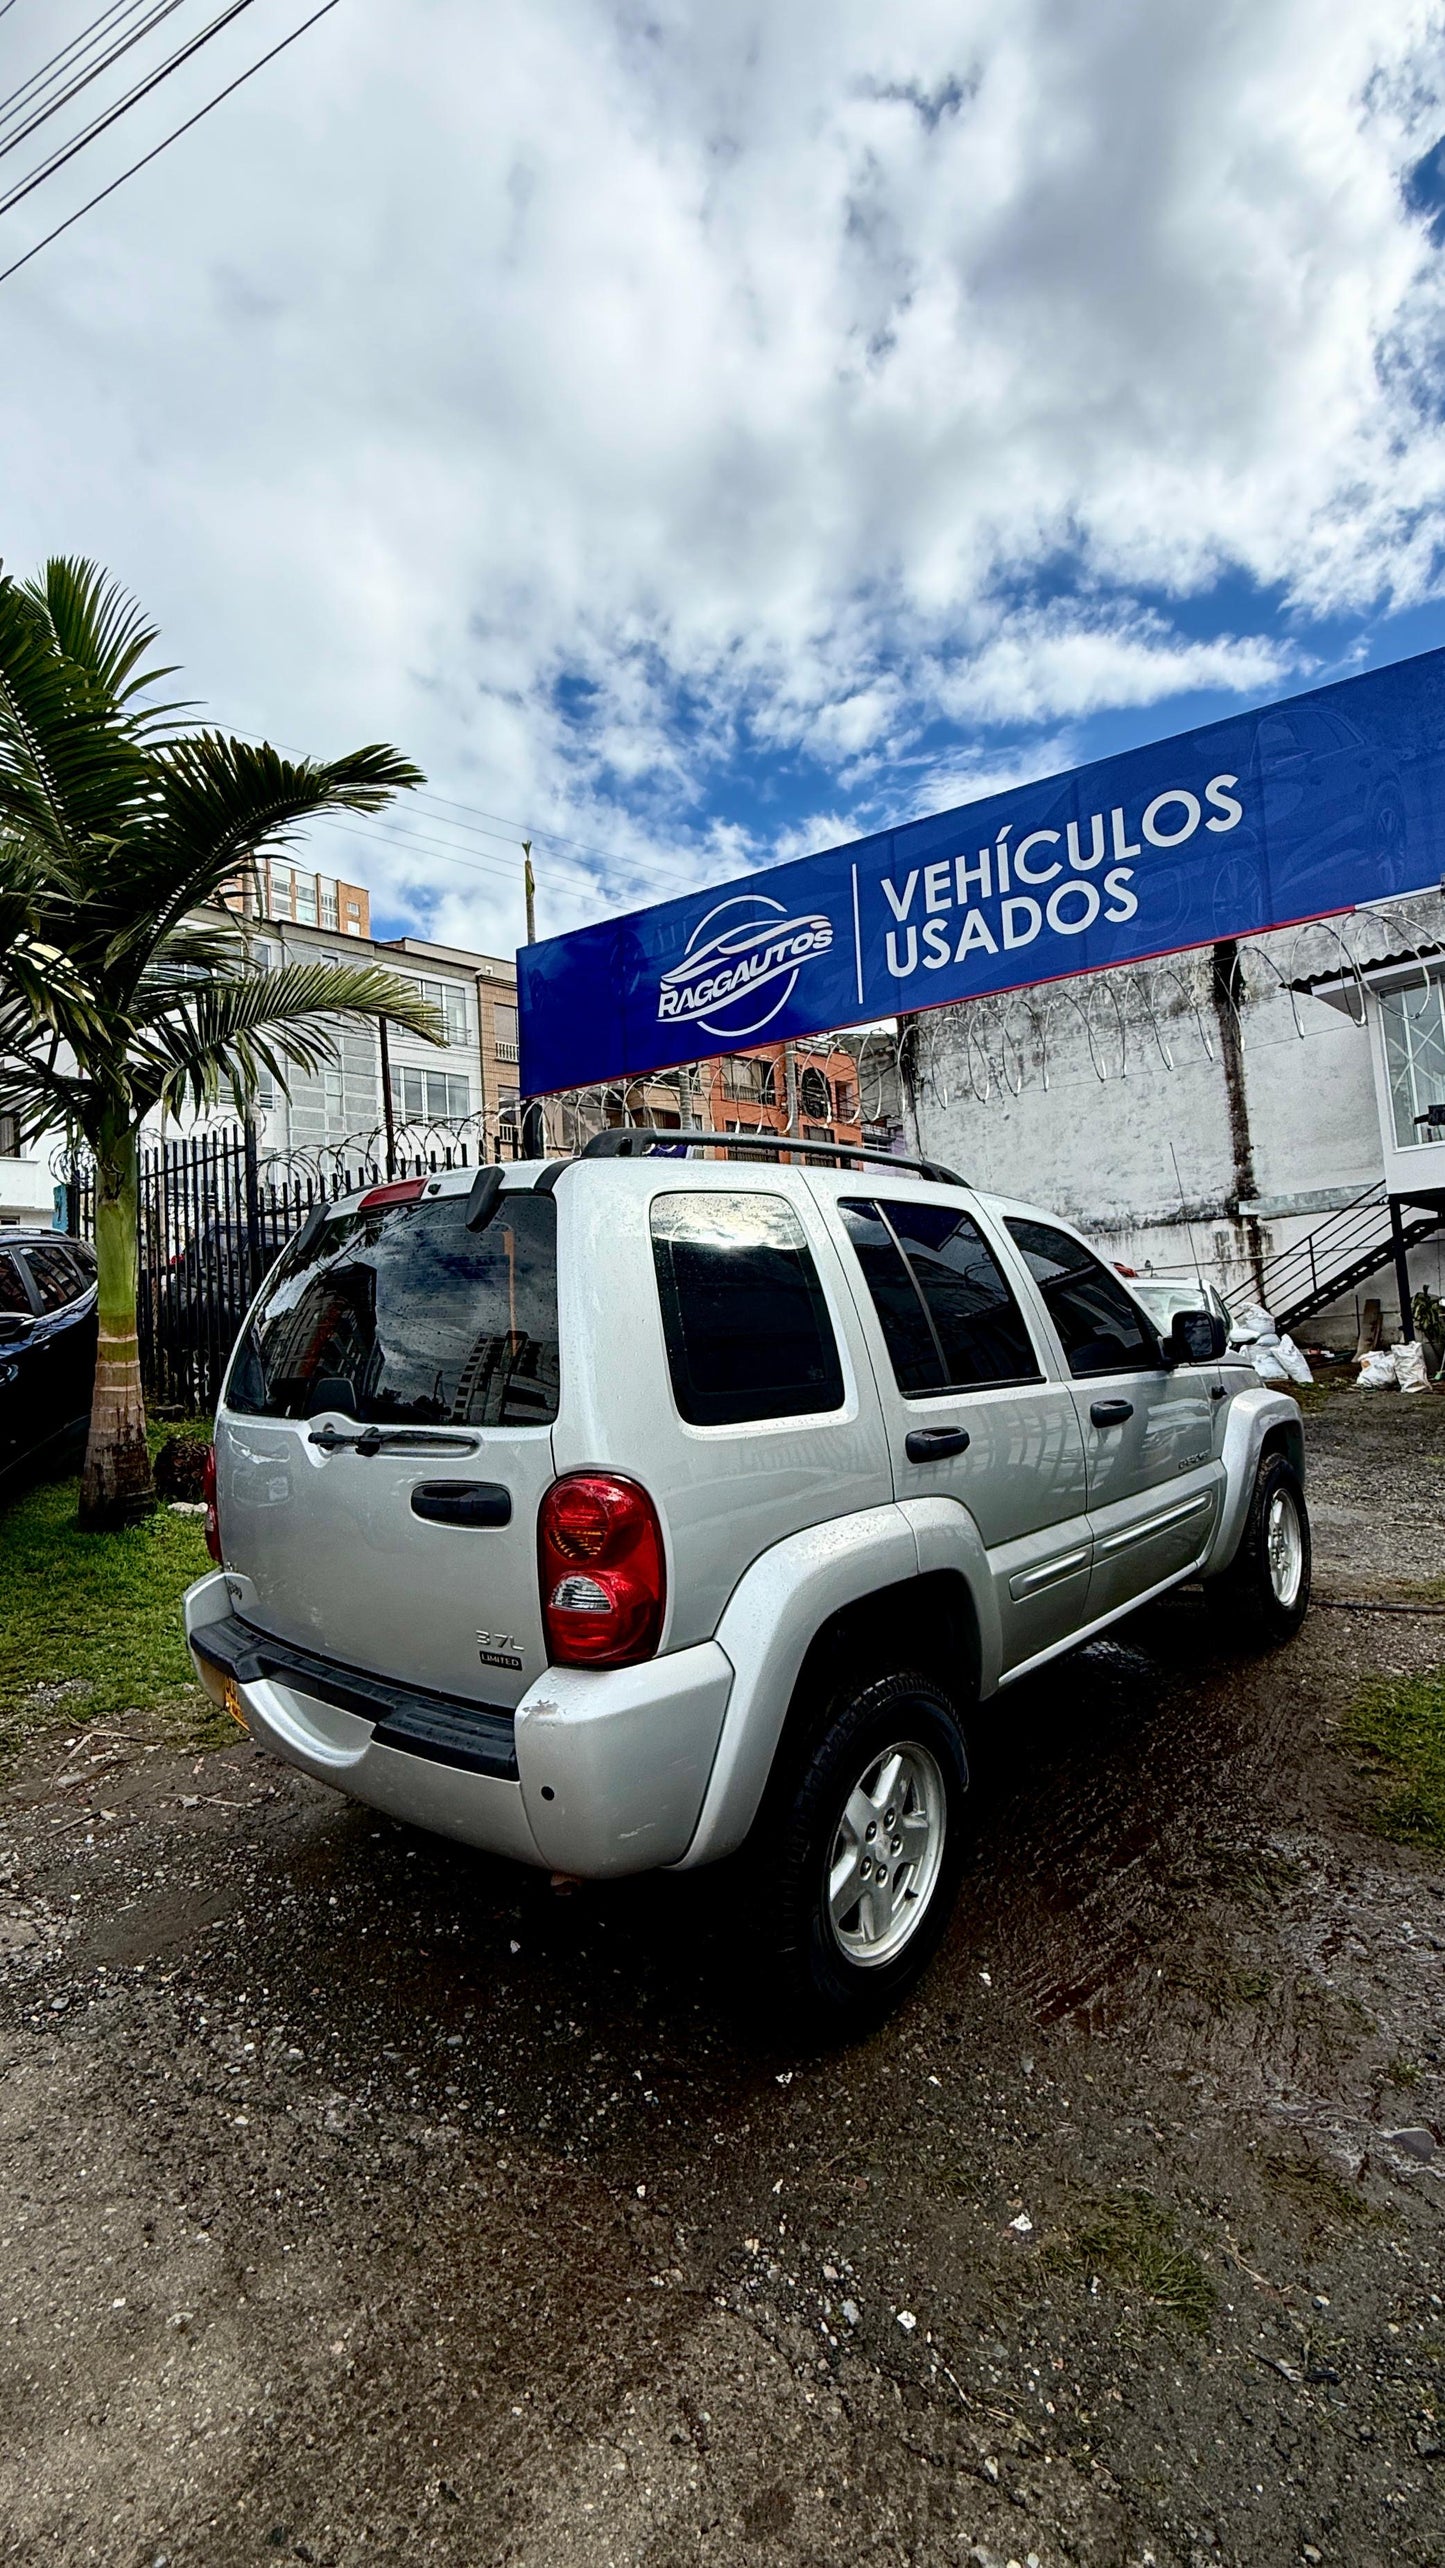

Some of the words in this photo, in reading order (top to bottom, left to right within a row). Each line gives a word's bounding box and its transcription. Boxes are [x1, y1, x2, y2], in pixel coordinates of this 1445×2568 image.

[880, 774, 1243, 922] VEHÍCULOS
[886, 867, 1138, 978] USADOS
[658, 929, 833, 1017] RAGGAUTOS
[481, 1653, 520, 1667] LIMITED
